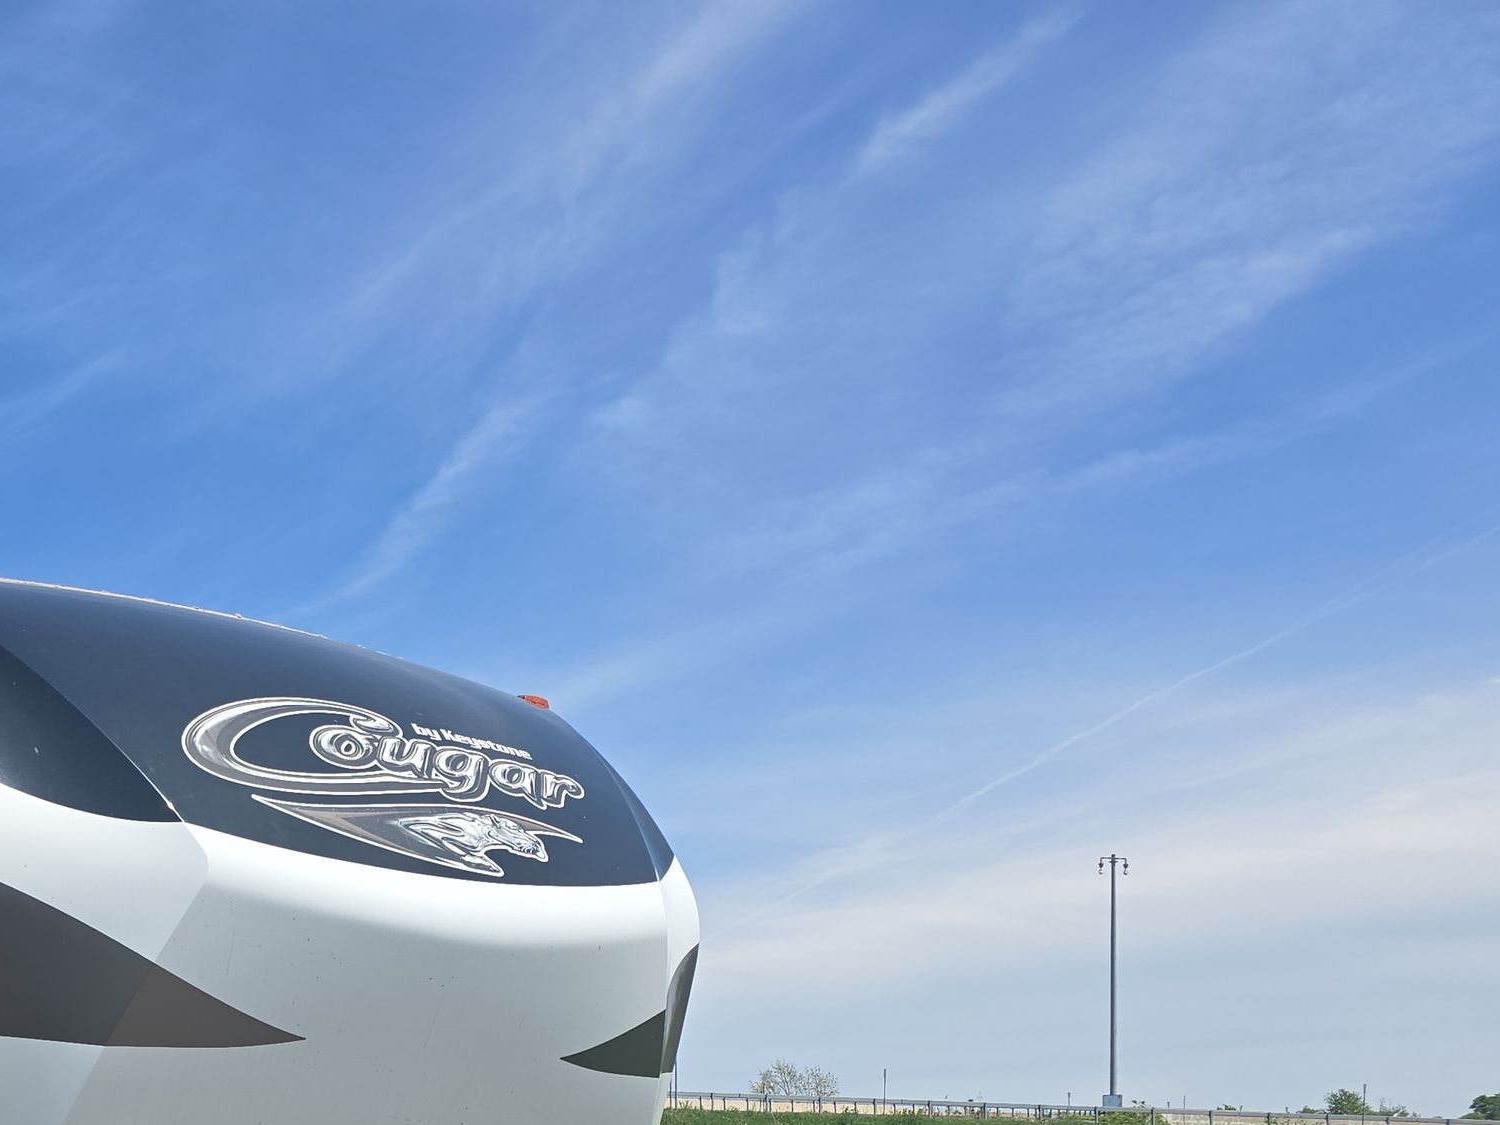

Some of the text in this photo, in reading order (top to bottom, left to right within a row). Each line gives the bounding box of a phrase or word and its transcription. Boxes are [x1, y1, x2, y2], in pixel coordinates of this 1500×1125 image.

[181, 697, 586, 809] Cougar
[411, 722, 533, 760] by Keystone
